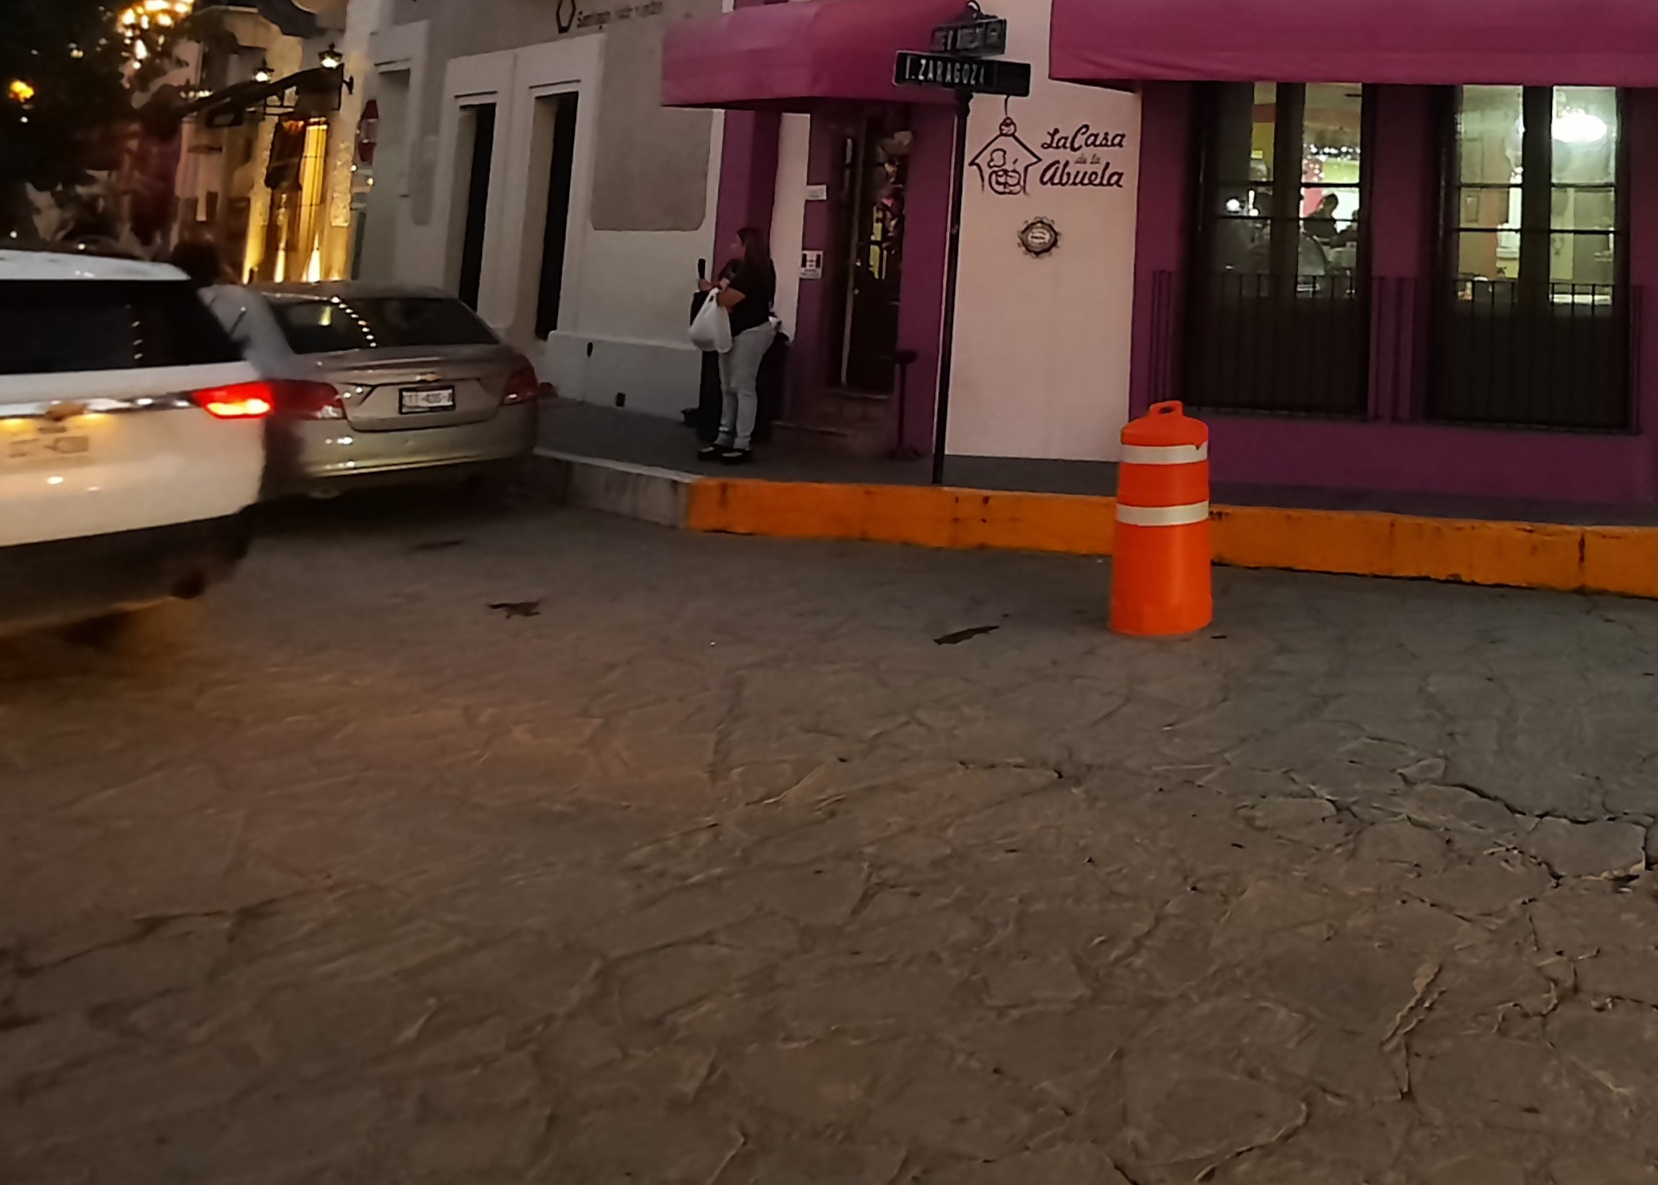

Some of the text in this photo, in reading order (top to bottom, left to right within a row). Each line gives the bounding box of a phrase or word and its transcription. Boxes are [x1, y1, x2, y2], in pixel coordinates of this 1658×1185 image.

[918, 58, 985, 86] ZARAGOZA
[1040, 123, 1127, 153] La Casa
[1039, 159, 1125, 189] Abuela
